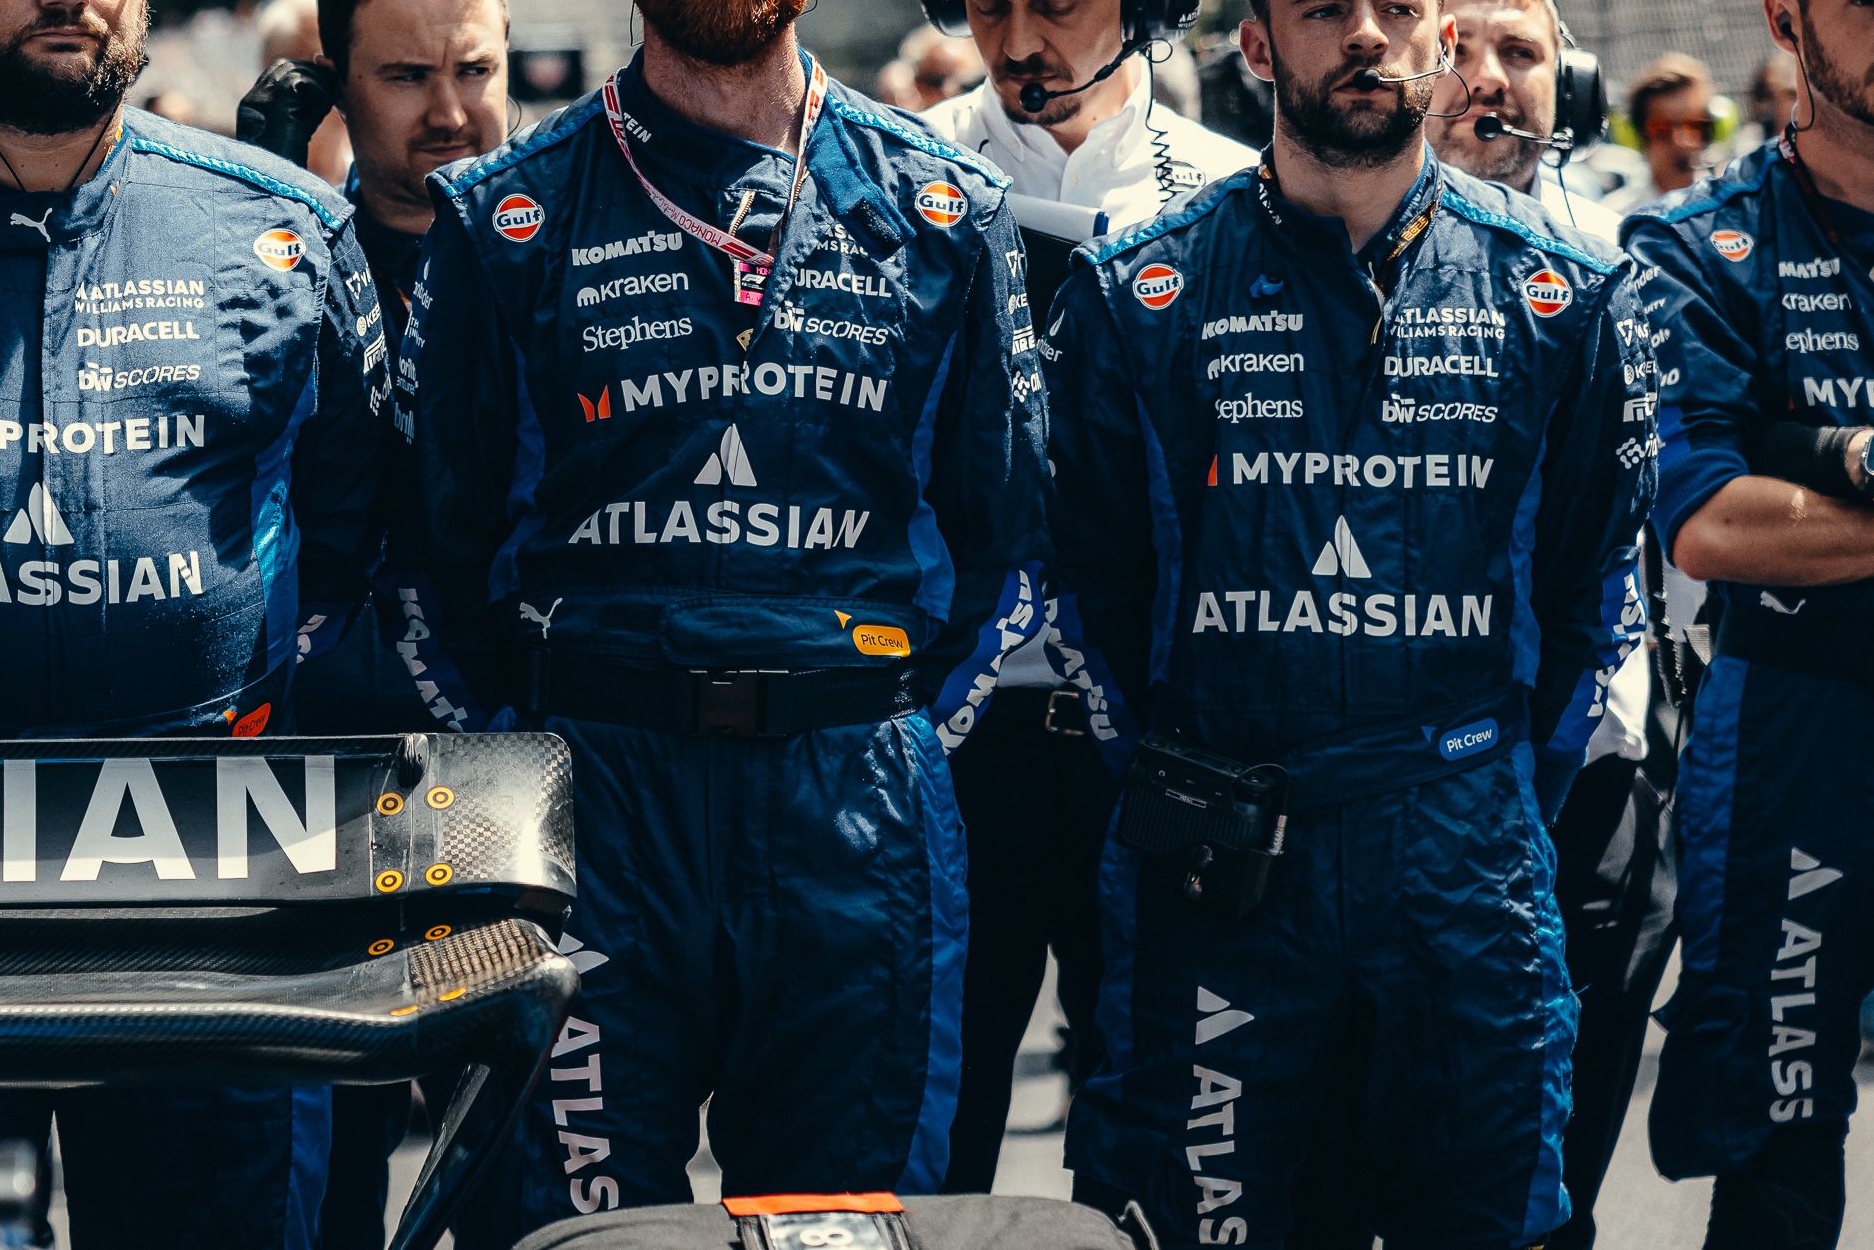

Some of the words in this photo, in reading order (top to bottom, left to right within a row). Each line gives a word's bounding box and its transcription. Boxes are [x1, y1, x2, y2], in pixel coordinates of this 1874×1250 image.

[919, 194, 964, 213] Gulf
[496, 208, 541, 228] Gulf
[677, 213, 722, 247] MONACO
[259, 242, 301, 257] Gulf
[572, 231, 683, 266] KOMATSU
[90, 280, 204, 301] ATLASSIAN
[1136, 277, 1180, 296] Gulf
[1526, 284, 1570, 302] Gulf
[75, 298, 144, 315] WILLIAMS
[146, 297, 204, 310] RACING
[77, 321, 200, 347] DURACELL
[582, 316, 693, 352] Stephens
[1202, 310, 1304, 340] KOMATSU
[1448, 325, 1506, 340] RACING
[1384, 355, 1500, 378] DURACELL
[621, 360, 888, 412] MYPROTEIN
[1233, 452, 1494, 489] MYPROTEIN
[568, 500, 870, 550] ATLASSIAN
[1192, 590, 1493, 638] ATLASSIAN
[860, 633, 876, 647] Pit
[877, 634, 904, 650] Crew
[1446, 736, 1463, 752] Pit
[1464, 727, 1493, 748] Crew
